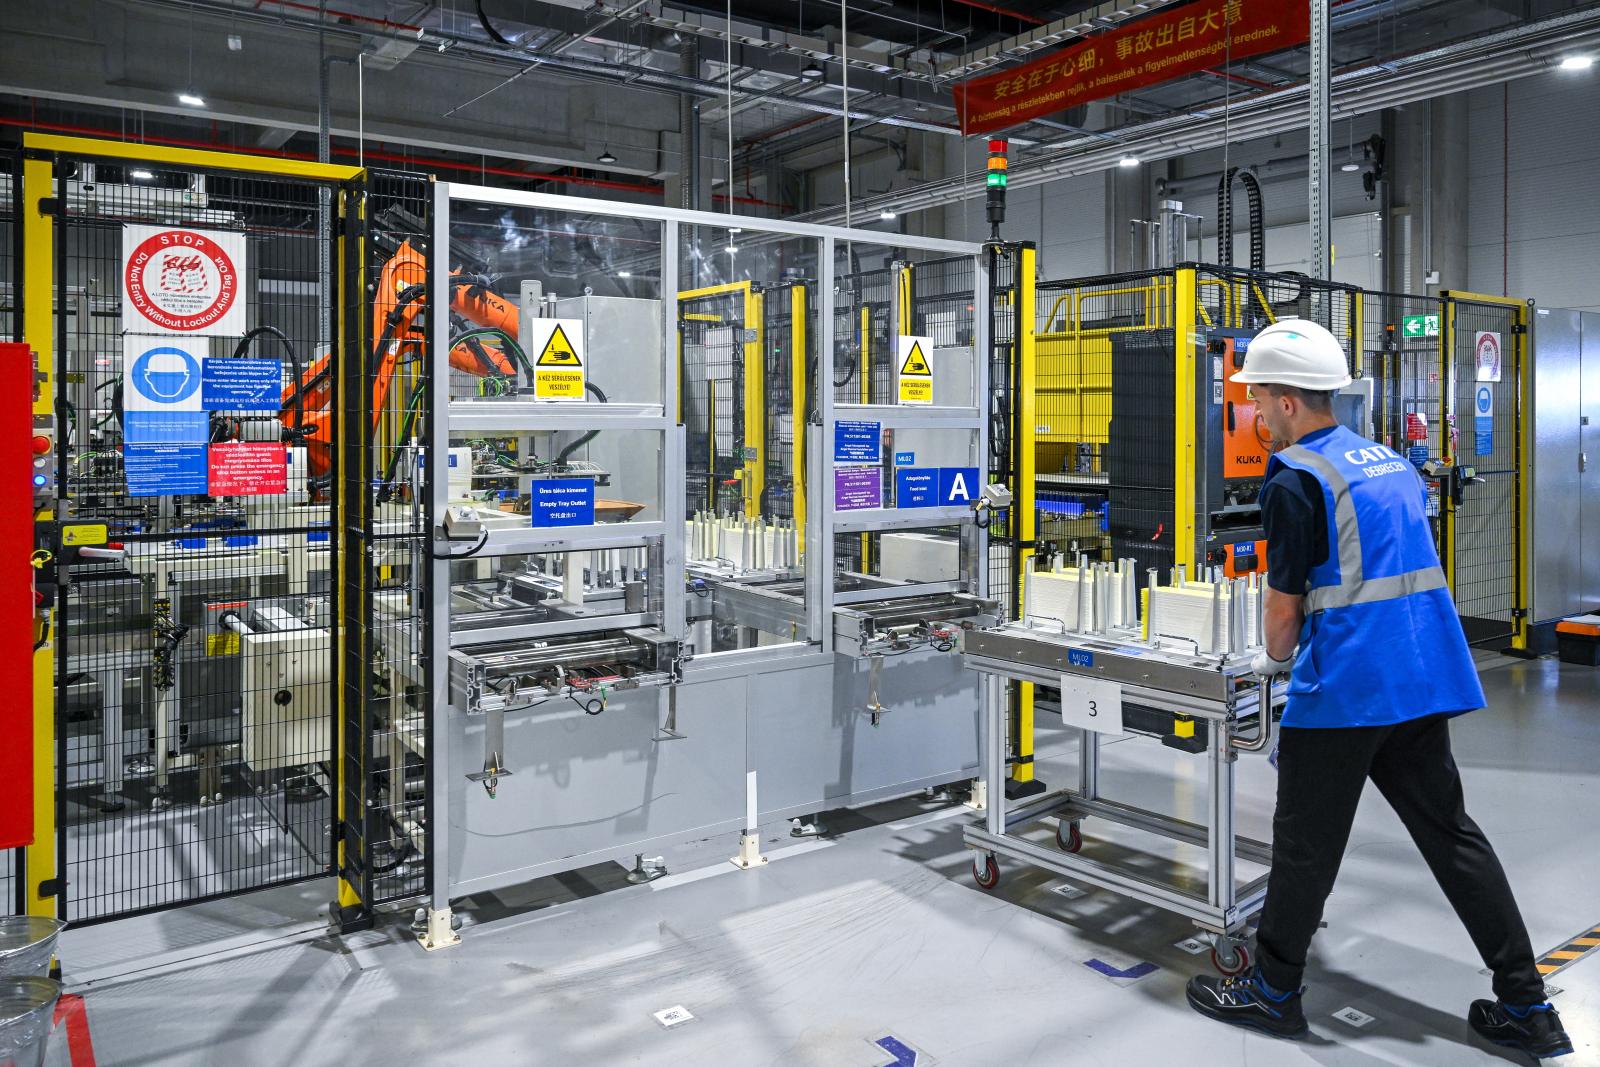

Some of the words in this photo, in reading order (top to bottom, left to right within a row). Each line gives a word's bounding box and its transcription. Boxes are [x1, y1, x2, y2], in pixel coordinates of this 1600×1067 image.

[970, 115, 977, 124] A
[1089, 80, 1094, 88] a
[1096, 66, 1136, 86] balesetek
[1138, 66, 1142, 74] a
[1234, 25, 1280, 45] erednek.
[160, 234, 205, 247] STOP
[135, 252, 149, 265] Do
[215, 256, 228, 273] Out
[130, 265, 141, 282] Not
[224, 274, 233, 292] Tag
[131, 283, 146, 308] Entry
[217, 293, 230, 311] And
[145, 305, 181, 328] Without
[183, 308, 220, 328] Lockout
[1236, 456, 1262, 464] KUKA
[1344, 446, 1400, 464] CATL
[1362, 461, 1408, 478] DEBRECEN
[948, 472, 970, 500] A
[1072, 653, 1089, 662] ML02
[1088, 700, 1097, 717] 3
